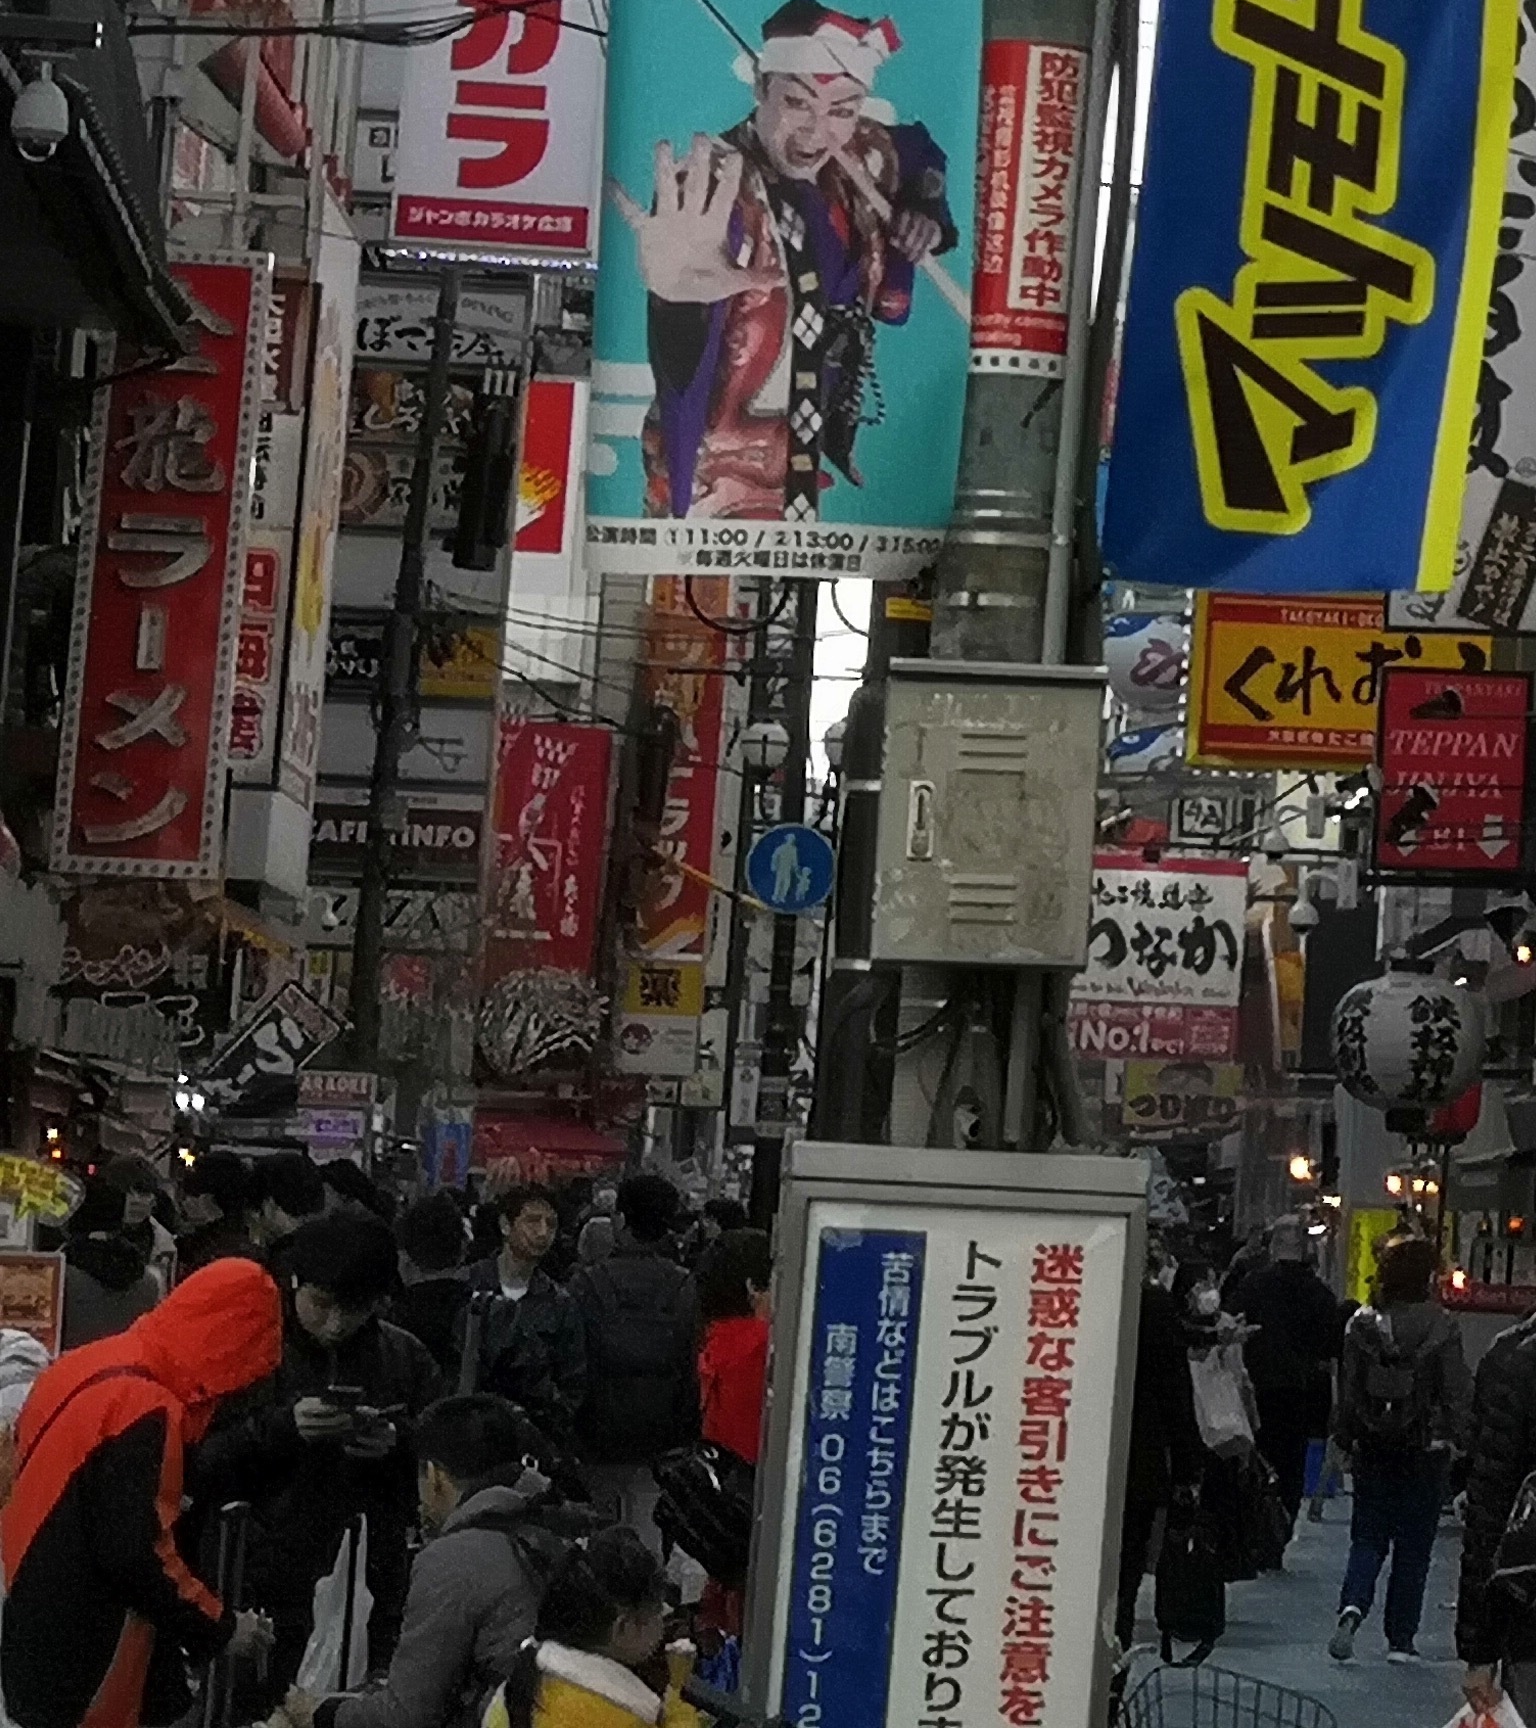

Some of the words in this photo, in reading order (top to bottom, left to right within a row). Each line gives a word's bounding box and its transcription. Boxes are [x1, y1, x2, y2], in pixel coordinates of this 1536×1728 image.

[1019, 51, 1079, 307] 防犯監視カメラ作動中
[401, 824, 476, 848] INFO
[1386, 729, 1518, 758] TEPPAN
[856, 1252, 913, 1575] 苦情などはこちらまで
[918, 1240, 1002, 1728] トラブルが発生しており
[998, 1242, 1085, 1726] 迷惑な客引きにご注意を
